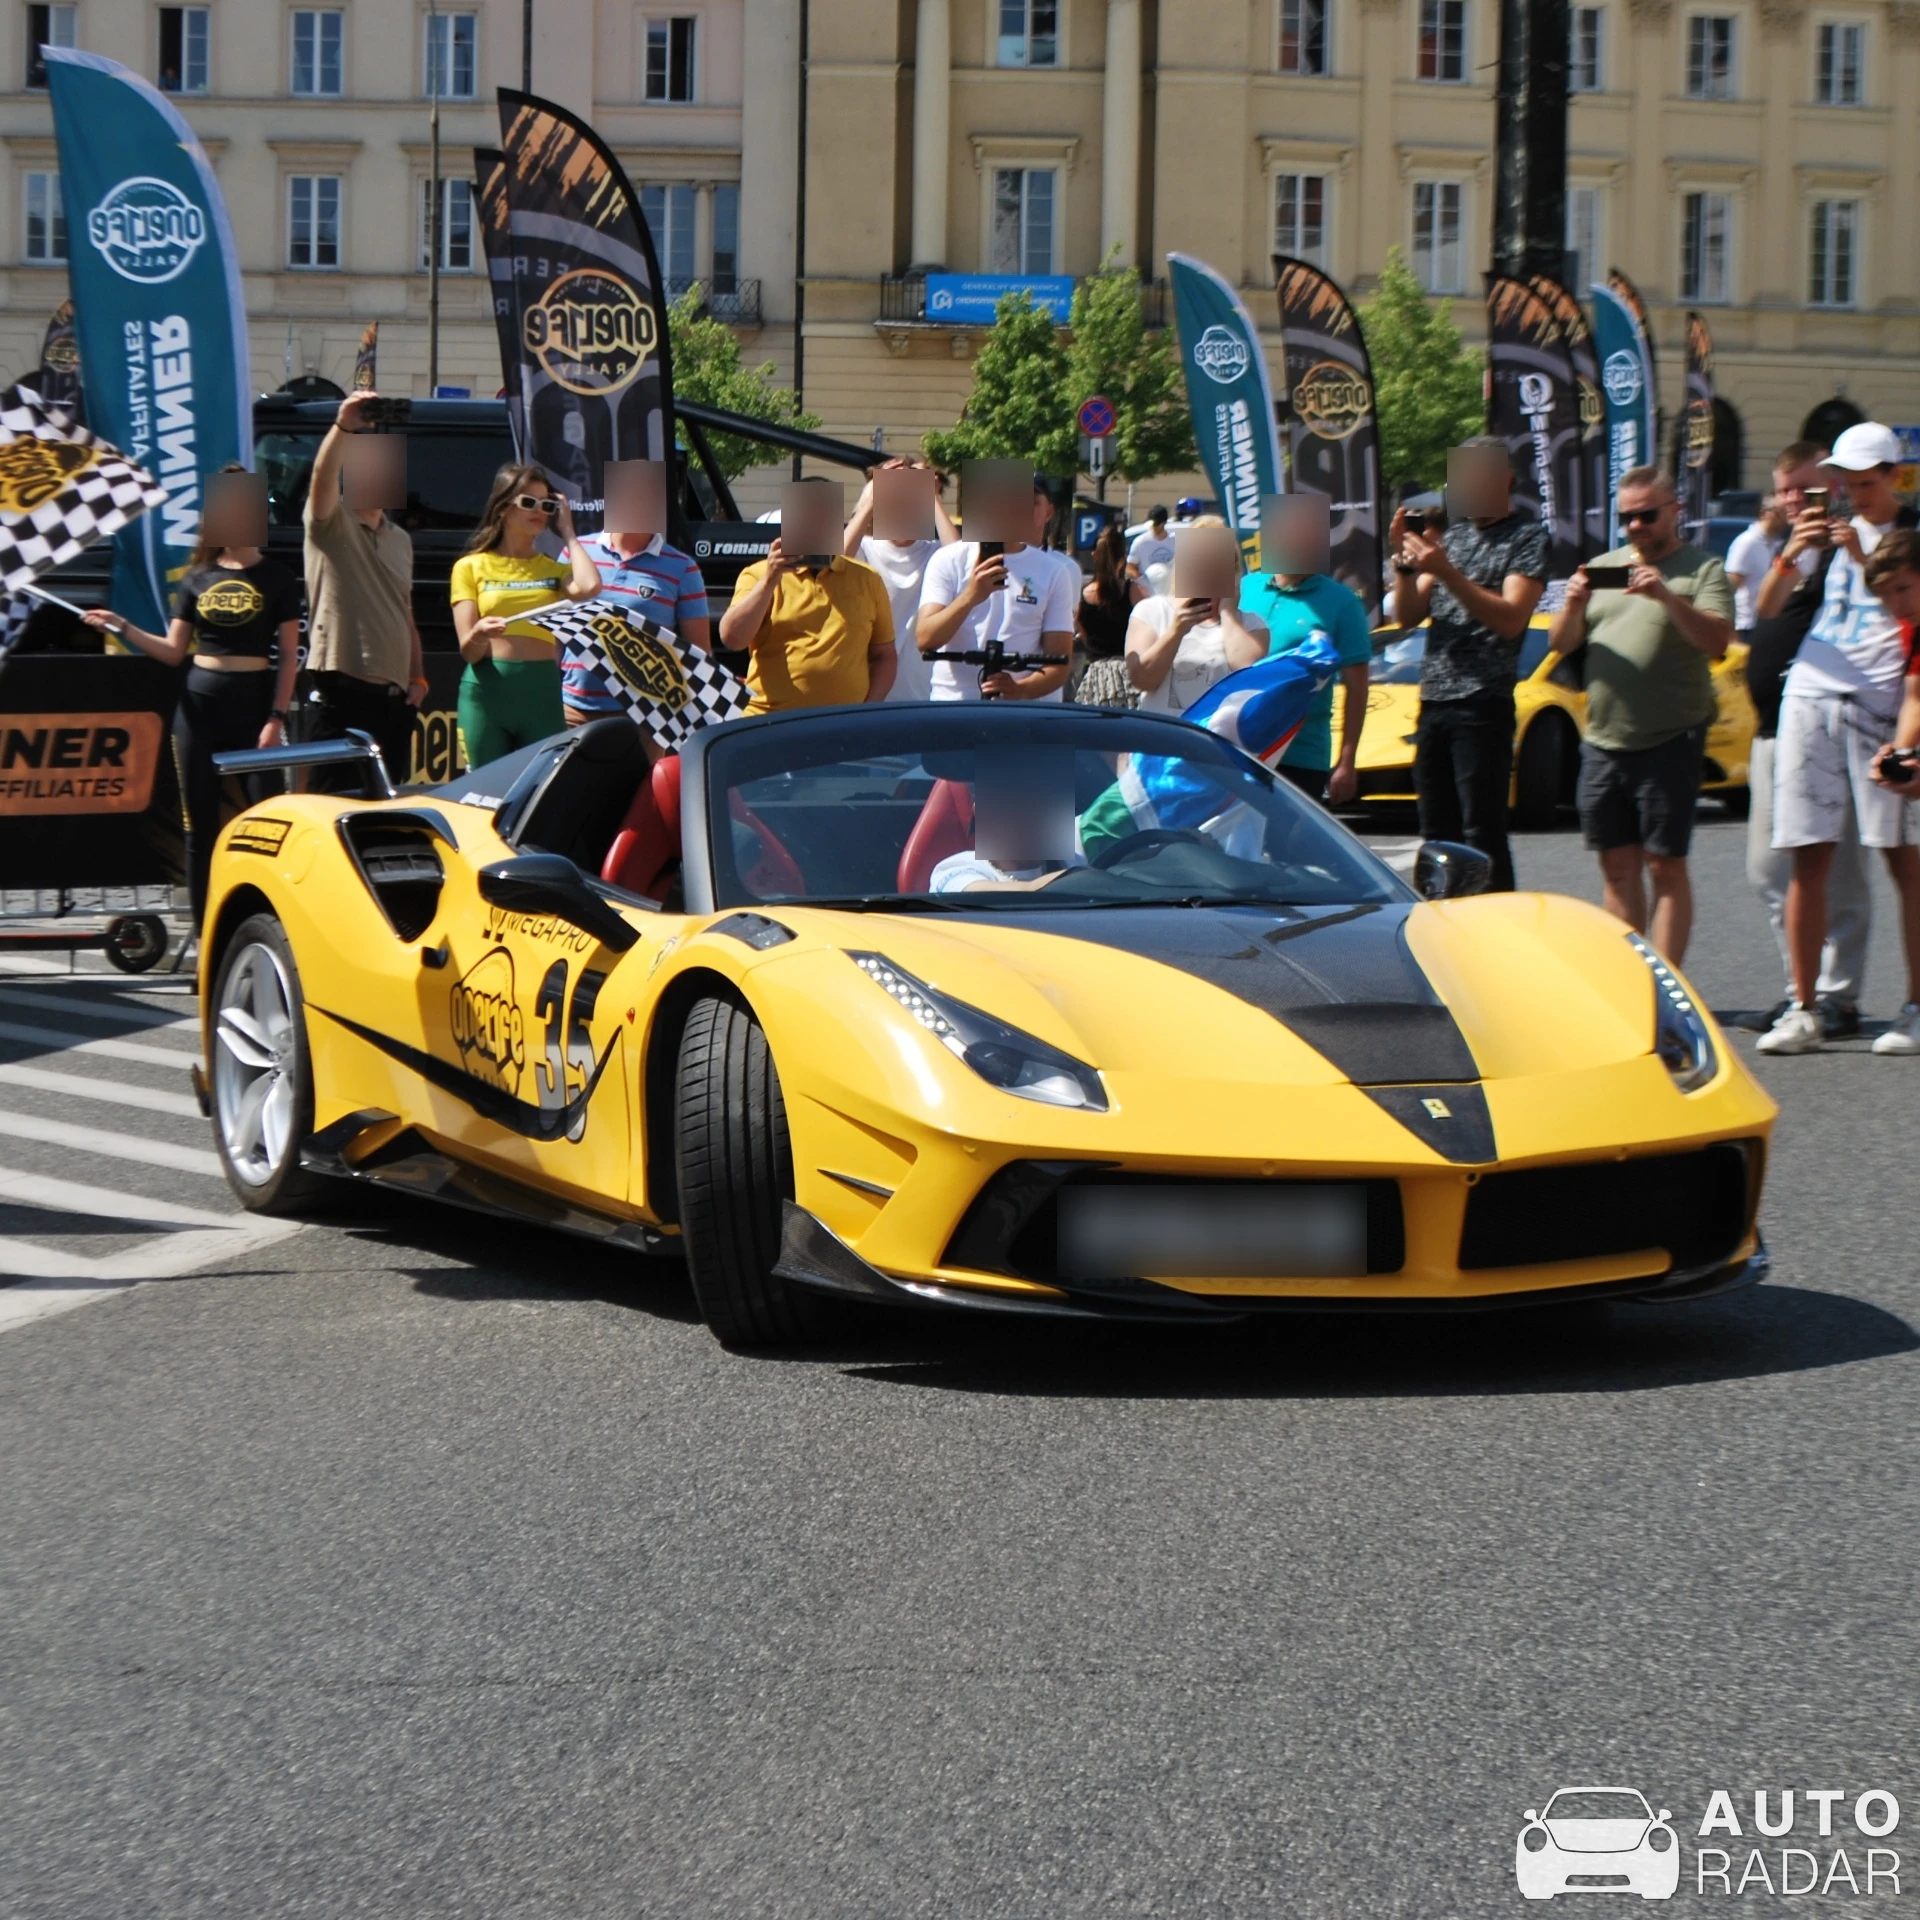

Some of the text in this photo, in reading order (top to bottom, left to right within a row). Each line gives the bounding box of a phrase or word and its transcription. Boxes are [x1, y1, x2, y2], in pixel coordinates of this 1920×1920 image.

[1081, 517, 1098, 543] P
[713, 541, 771, 555] roman
[534, 957, 607, 1145] 35
